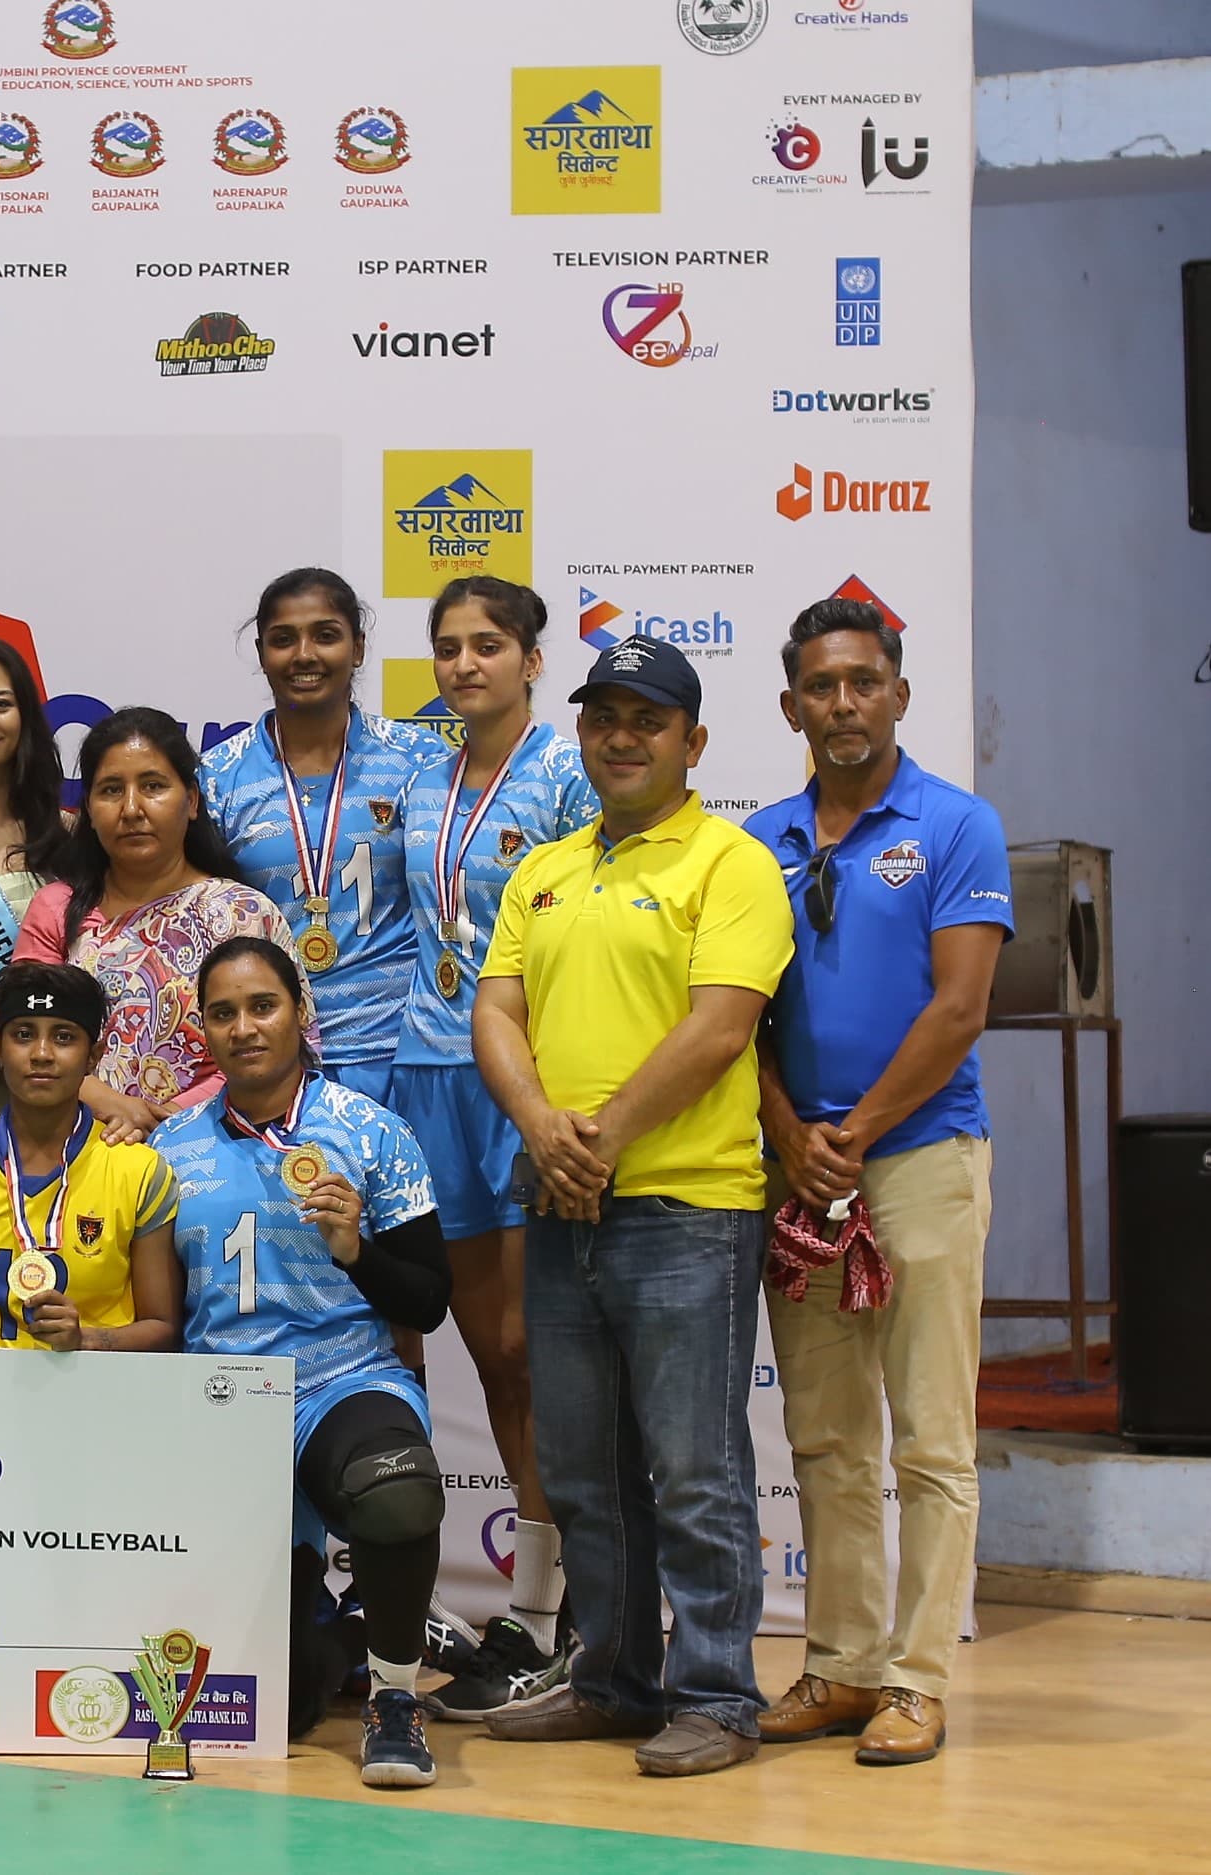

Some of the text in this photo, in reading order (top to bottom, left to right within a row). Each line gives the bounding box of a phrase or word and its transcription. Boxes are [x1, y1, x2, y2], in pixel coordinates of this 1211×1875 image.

[795, 11, 909, 25] Creative Hands
[42, 66, 109, 76] PROVIENCE
[113, 65, 187, 75] GOVERMENT
[2, 80, 73, 90] EDUCATION,
[77, 80, 130, 90] SCIENCE,
[133, 79, 173, 88] YOUTH
[177, 78, 203, 87] AND
[207, 77, 253, 87] SPORTS
[784, 93, 922, 105] EVENT MANAGED BY
[523, 125, 653, 150] सगरमाथा
[557, 151, 619, 172] सिमेन्ट
[752, 175, 847, 185] CREATIVE GUNJ
[92, 187, 159, 198] BAIJANATH
[213, 187, 288, 197] NARENAPUR
[346, 185, 403, 195] DUDUWA
[92, 201, 159, 211] GAUPALIKA
[216, 200, 285, 211] GAUPALIKA
[340, 198, 410, 208] GAUPALIKA
[553, 250, 769, 267] TELEVISION PARTNER
[136, 261, 290, 278] FOOD PARTNER
[358, 259, 488, 275] ISP PARTNER
[658, 283, 684, 294] HD
[352, 322, 497, 357] vianet
[163, 356, 266, 375] Your Time Your Place
[773, 389, 930, 412] Dotworks
[823, 471, 931, 512] Daraz
[395, 509, 524, 533] सगरमाथा
[428, 534, 491, 556] सिमेन्ट
[568, 564, 754, 575] DIGITAL PAYMENT PARTNER
[635, 611, 733, 643] iCash
[873, 858, 922, 871] GODAWARI
[222, 1211, 257, 1314] 1
[246, 1388, 271, 1396] Creative
[23, 1532, 188, 1552] VOLLEYBALL
[209, 1710, 249, 1725] BANK LTD.
